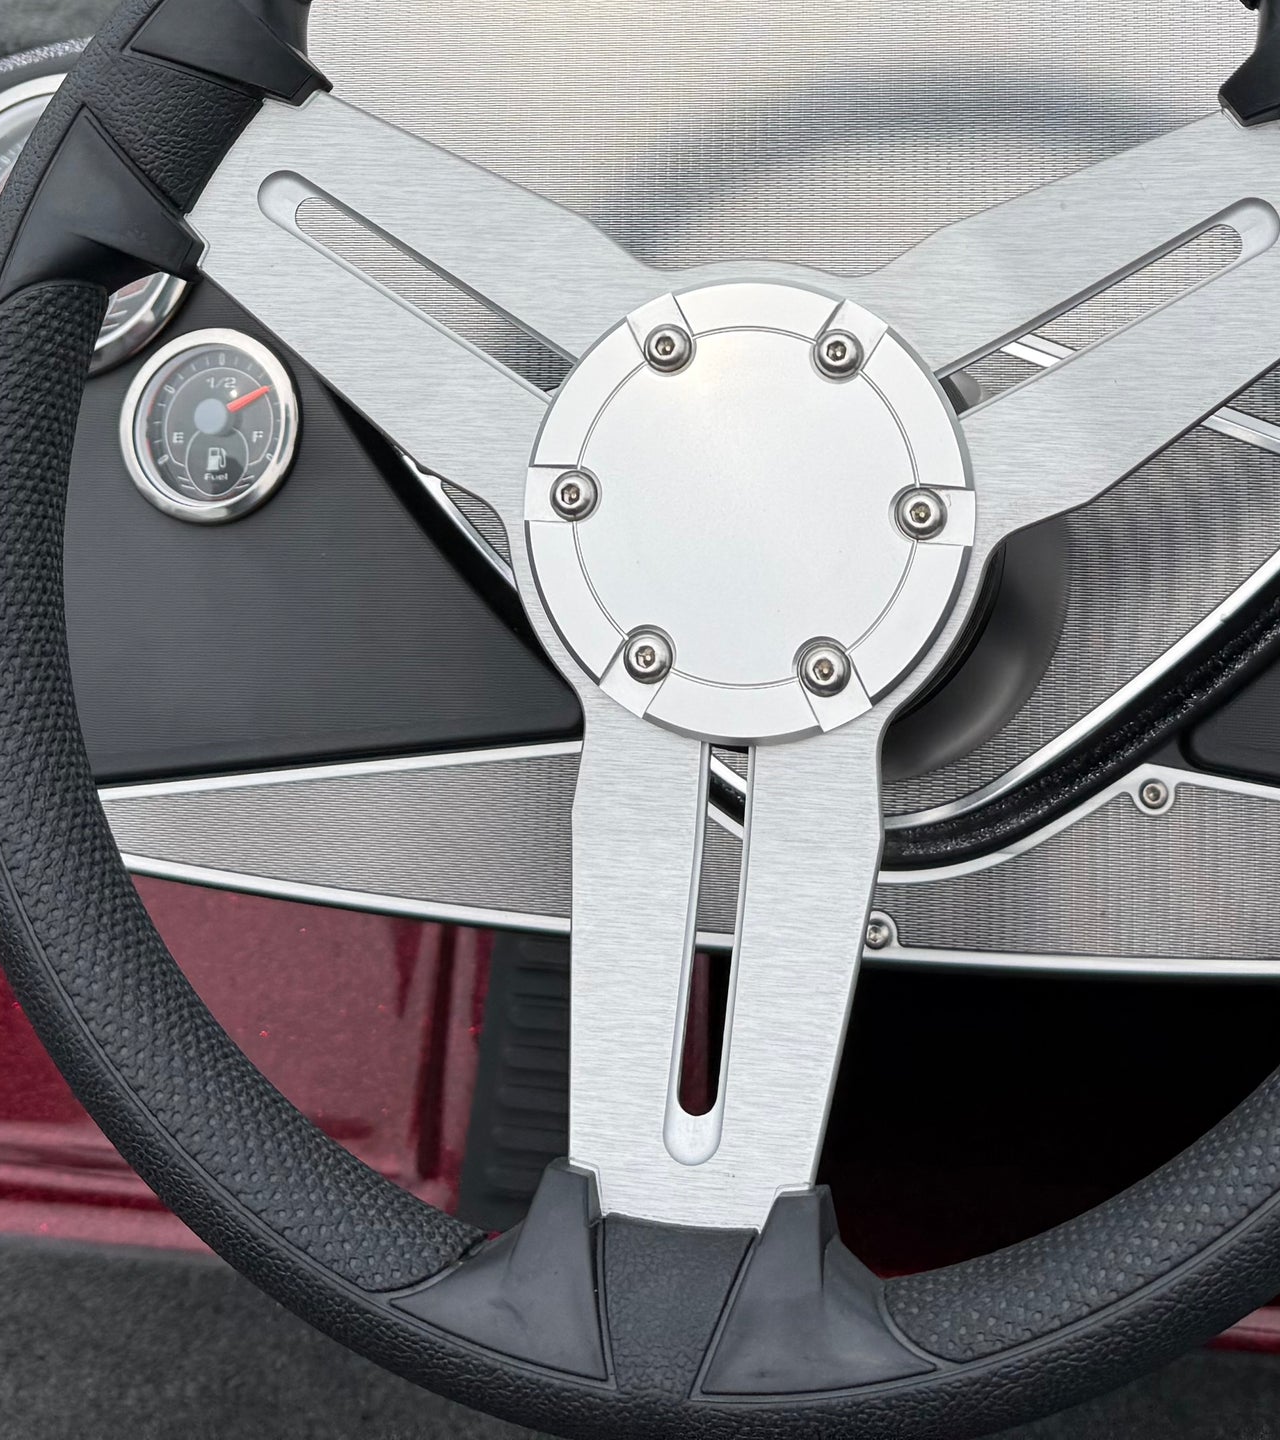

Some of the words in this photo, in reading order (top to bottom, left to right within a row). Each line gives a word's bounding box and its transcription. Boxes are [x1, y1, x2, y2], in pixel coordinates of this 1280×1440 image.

[205, 377, 238, 389] 1/2
[172, 431, 184, 444] E
[252, 430, 264, 443] F
[203, 472, 228, 481] Fuel
